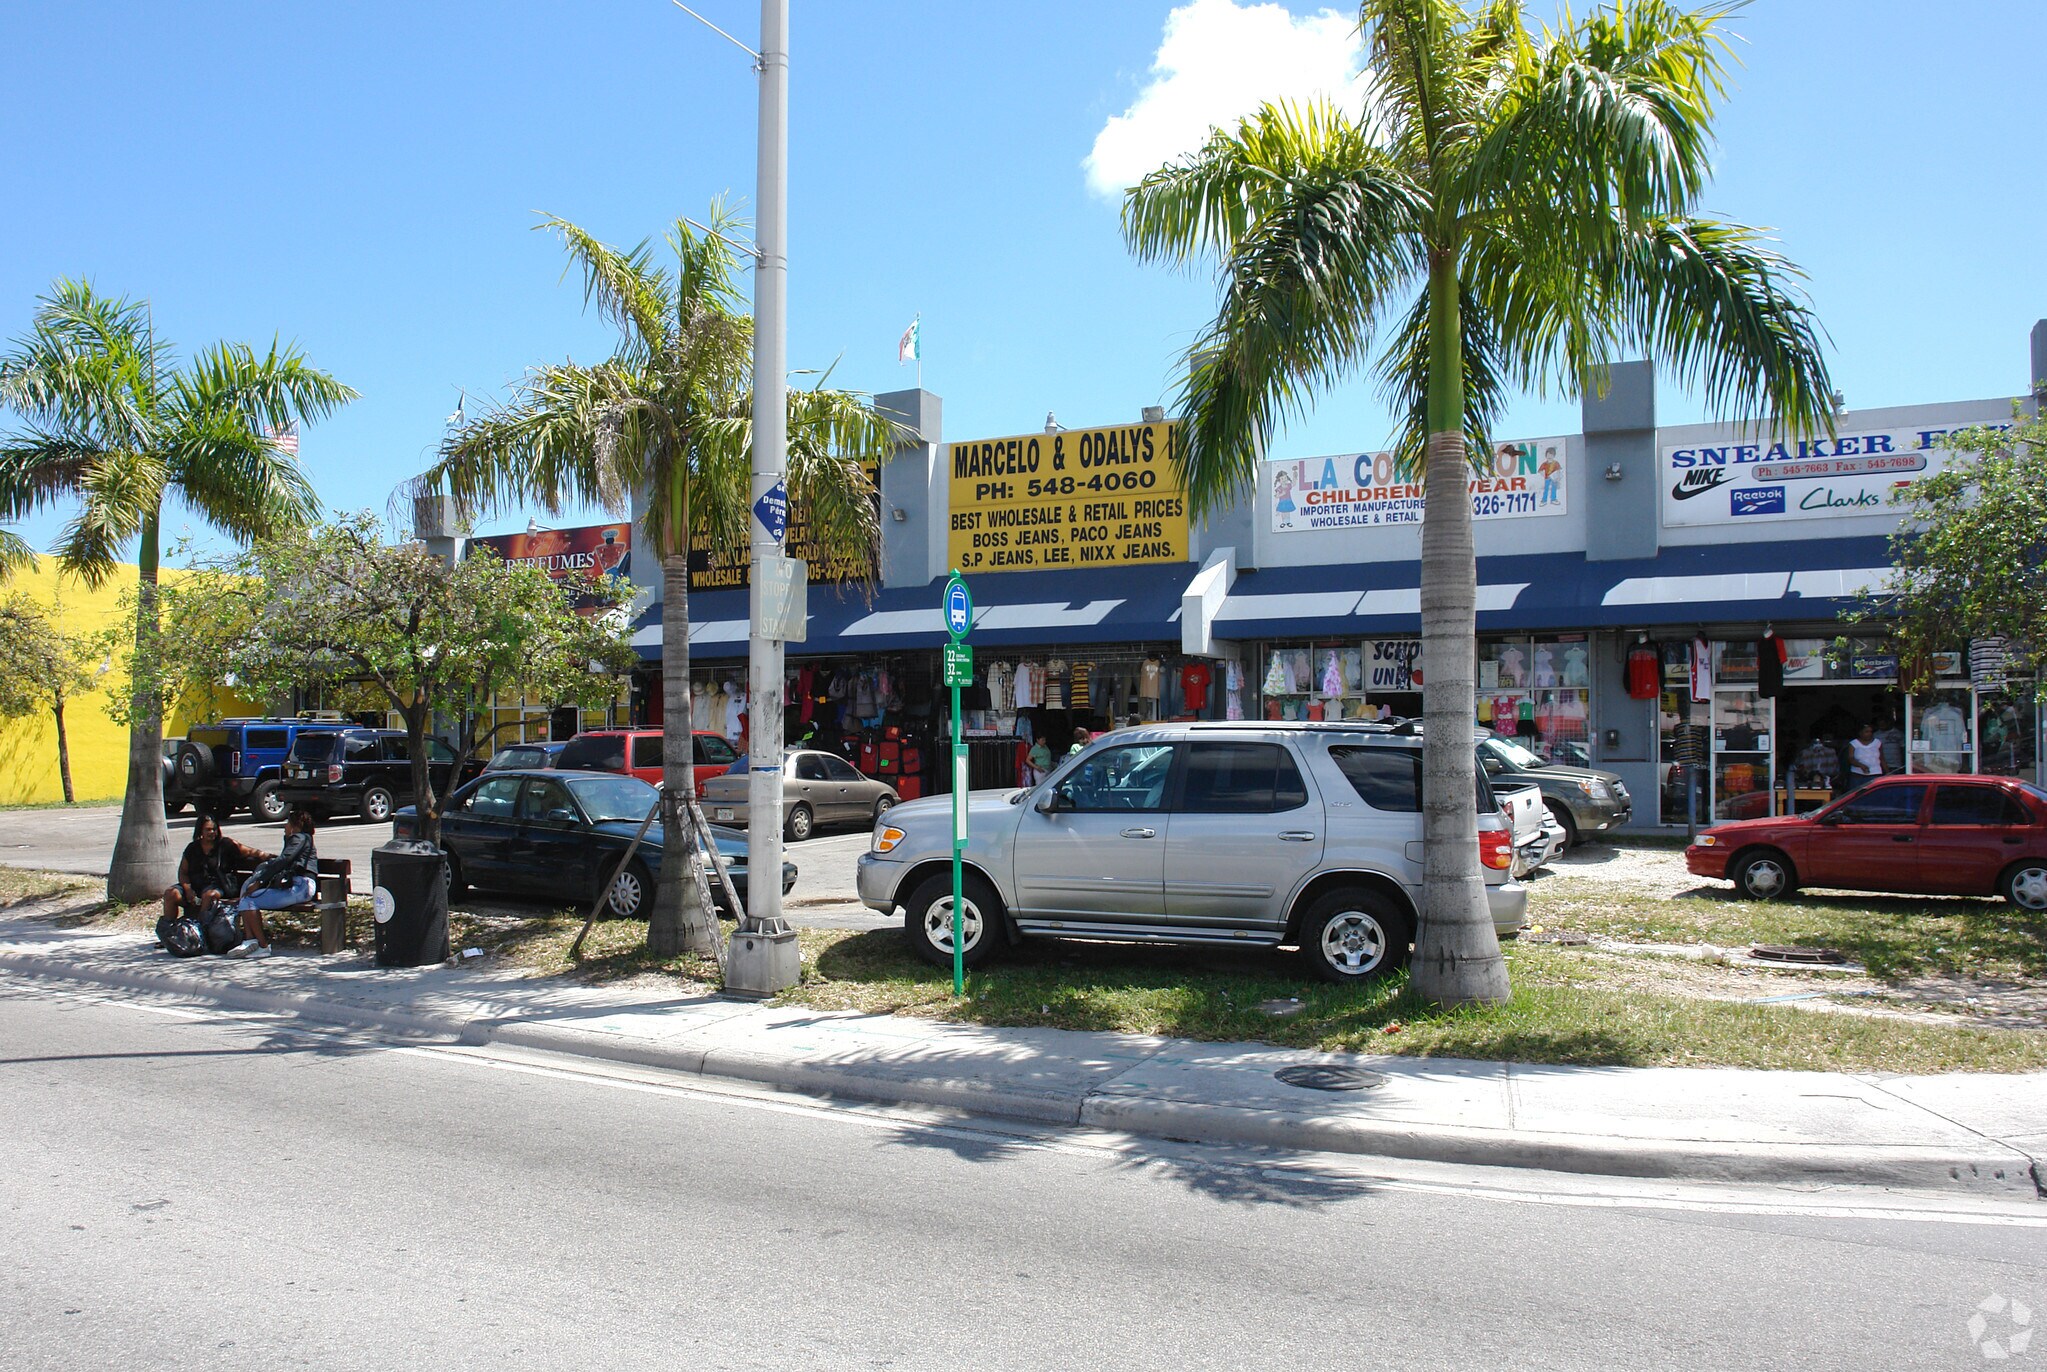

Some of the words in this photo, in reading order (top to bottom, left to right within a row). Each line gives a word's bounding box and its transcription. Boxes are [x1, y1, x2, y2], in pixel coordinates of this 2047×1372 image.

[954, 438, 1040, 478] MARCELO
[1053, 436, 1066, 471] &
[1079, 427, 1154, 468] ODALYS
[1672, 434, 1895, 469] SNEAKER
[1782, 462, 1829, 475] 545-7663
[1867, 457, 1916, 469] 545-7698
[976, 482, 1014, 500] PH:
[1027, 470, 1156, 497] 548-4060
[1683, 468, 1724, 486] NIKE
[1474, 492, 1536, 516] 326-7171
[1734, 489, 1783, 502] Reebok
[1800, 487, 1880, 511] Clarks
[952, 512, 982, 530] BEST
[988, 506, 1062, 528] WHOLESALE
[1068, 505, 1077, 523] &
[1084, 502, 1128, 522] RETAIL
[1134, 498, 1183, 518] PRICES
[1300, 503, 1348, 516] IMPORTER
[1353, 499, 1426, 513] MANUFACTURE
[1310, 514, 1368, 528] WHOLESALE
[1374, 513, 1380, 524] &
[1386, 511, 1419, 523] RETAIL
[973, 530, 1008, 548] BOSS
[1015, 528, 1065, 546] JEANS,
[1070, 525, 1108, 542] PACO
[1115, 522, 1162, 540] JEANS
[506, 551, 596, 573] PERFUMES
[962, 552, 982, 568] S.P
[989, 550, 1038, 566] JEANS,
[1044, 548, 1074, 564] LEE,
[1080, 545, 1116, 562] NIXX
[1122, 542, 1175, 559] JEANS.
[692, 568, 742, 588] WHOLESALE
[946, 650, 956, 662] 22
[1373, 641, 1423, 660] SCHO
[947, 662, 956, 675] 32
[1831, 660, 1838, 670] 6
